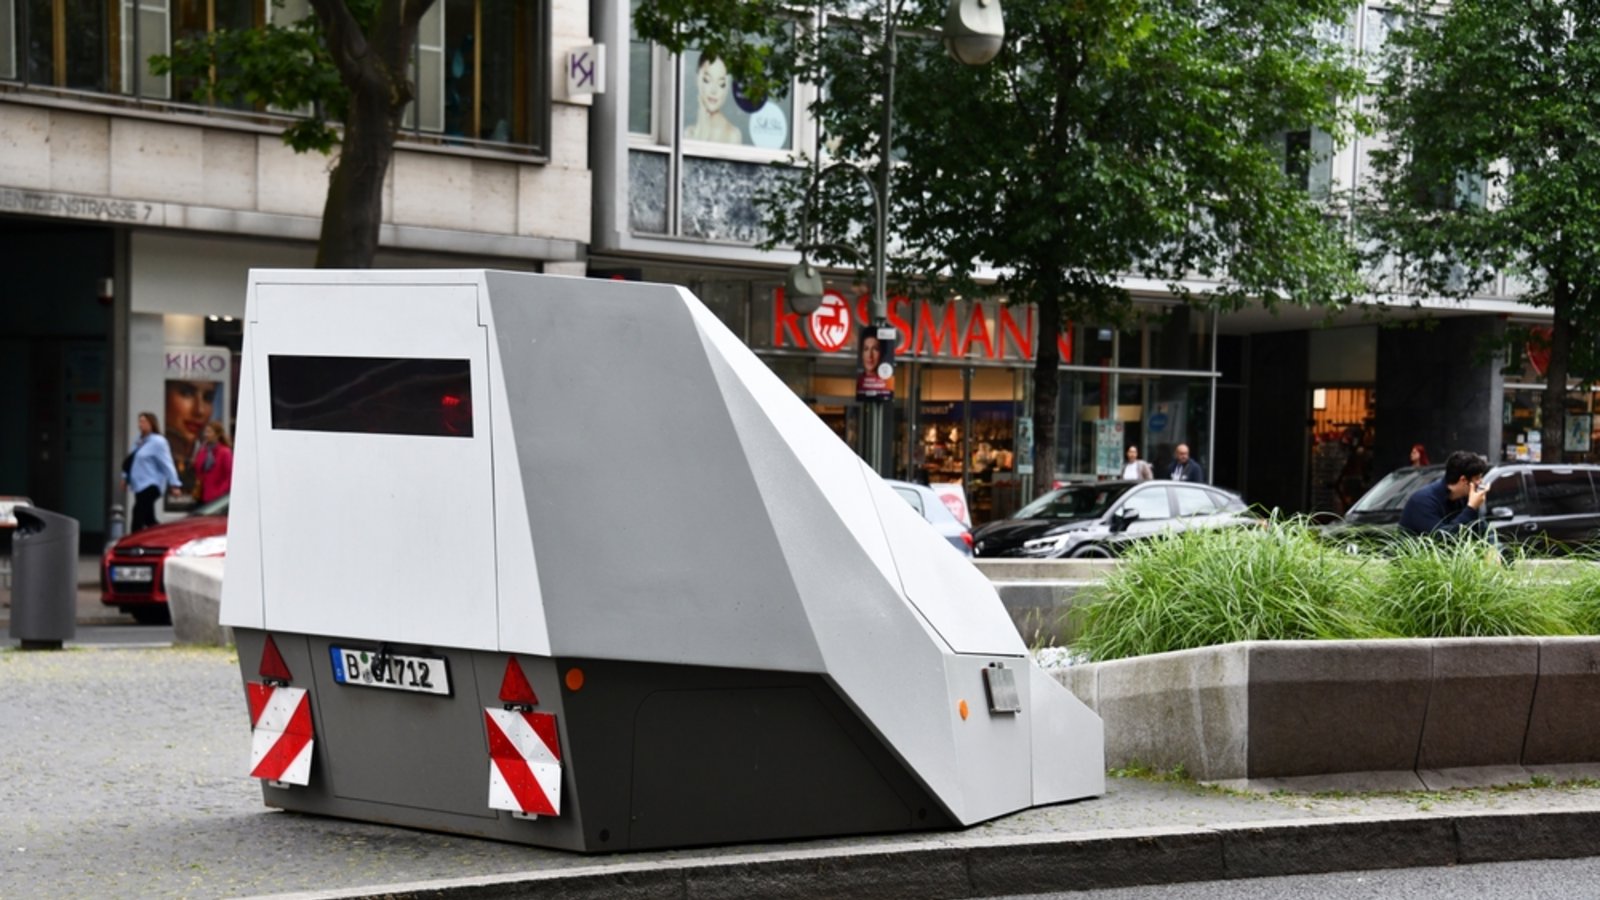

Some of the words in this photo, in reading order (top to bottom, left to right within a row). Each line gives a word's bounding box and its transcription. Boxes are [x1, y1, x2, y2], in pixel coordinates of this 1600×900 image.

[0, 191, 137, 220] ENTZIENSTRASSE
[166, 353, 226, 373] KIKO
[346, 654, 359, 679] B
